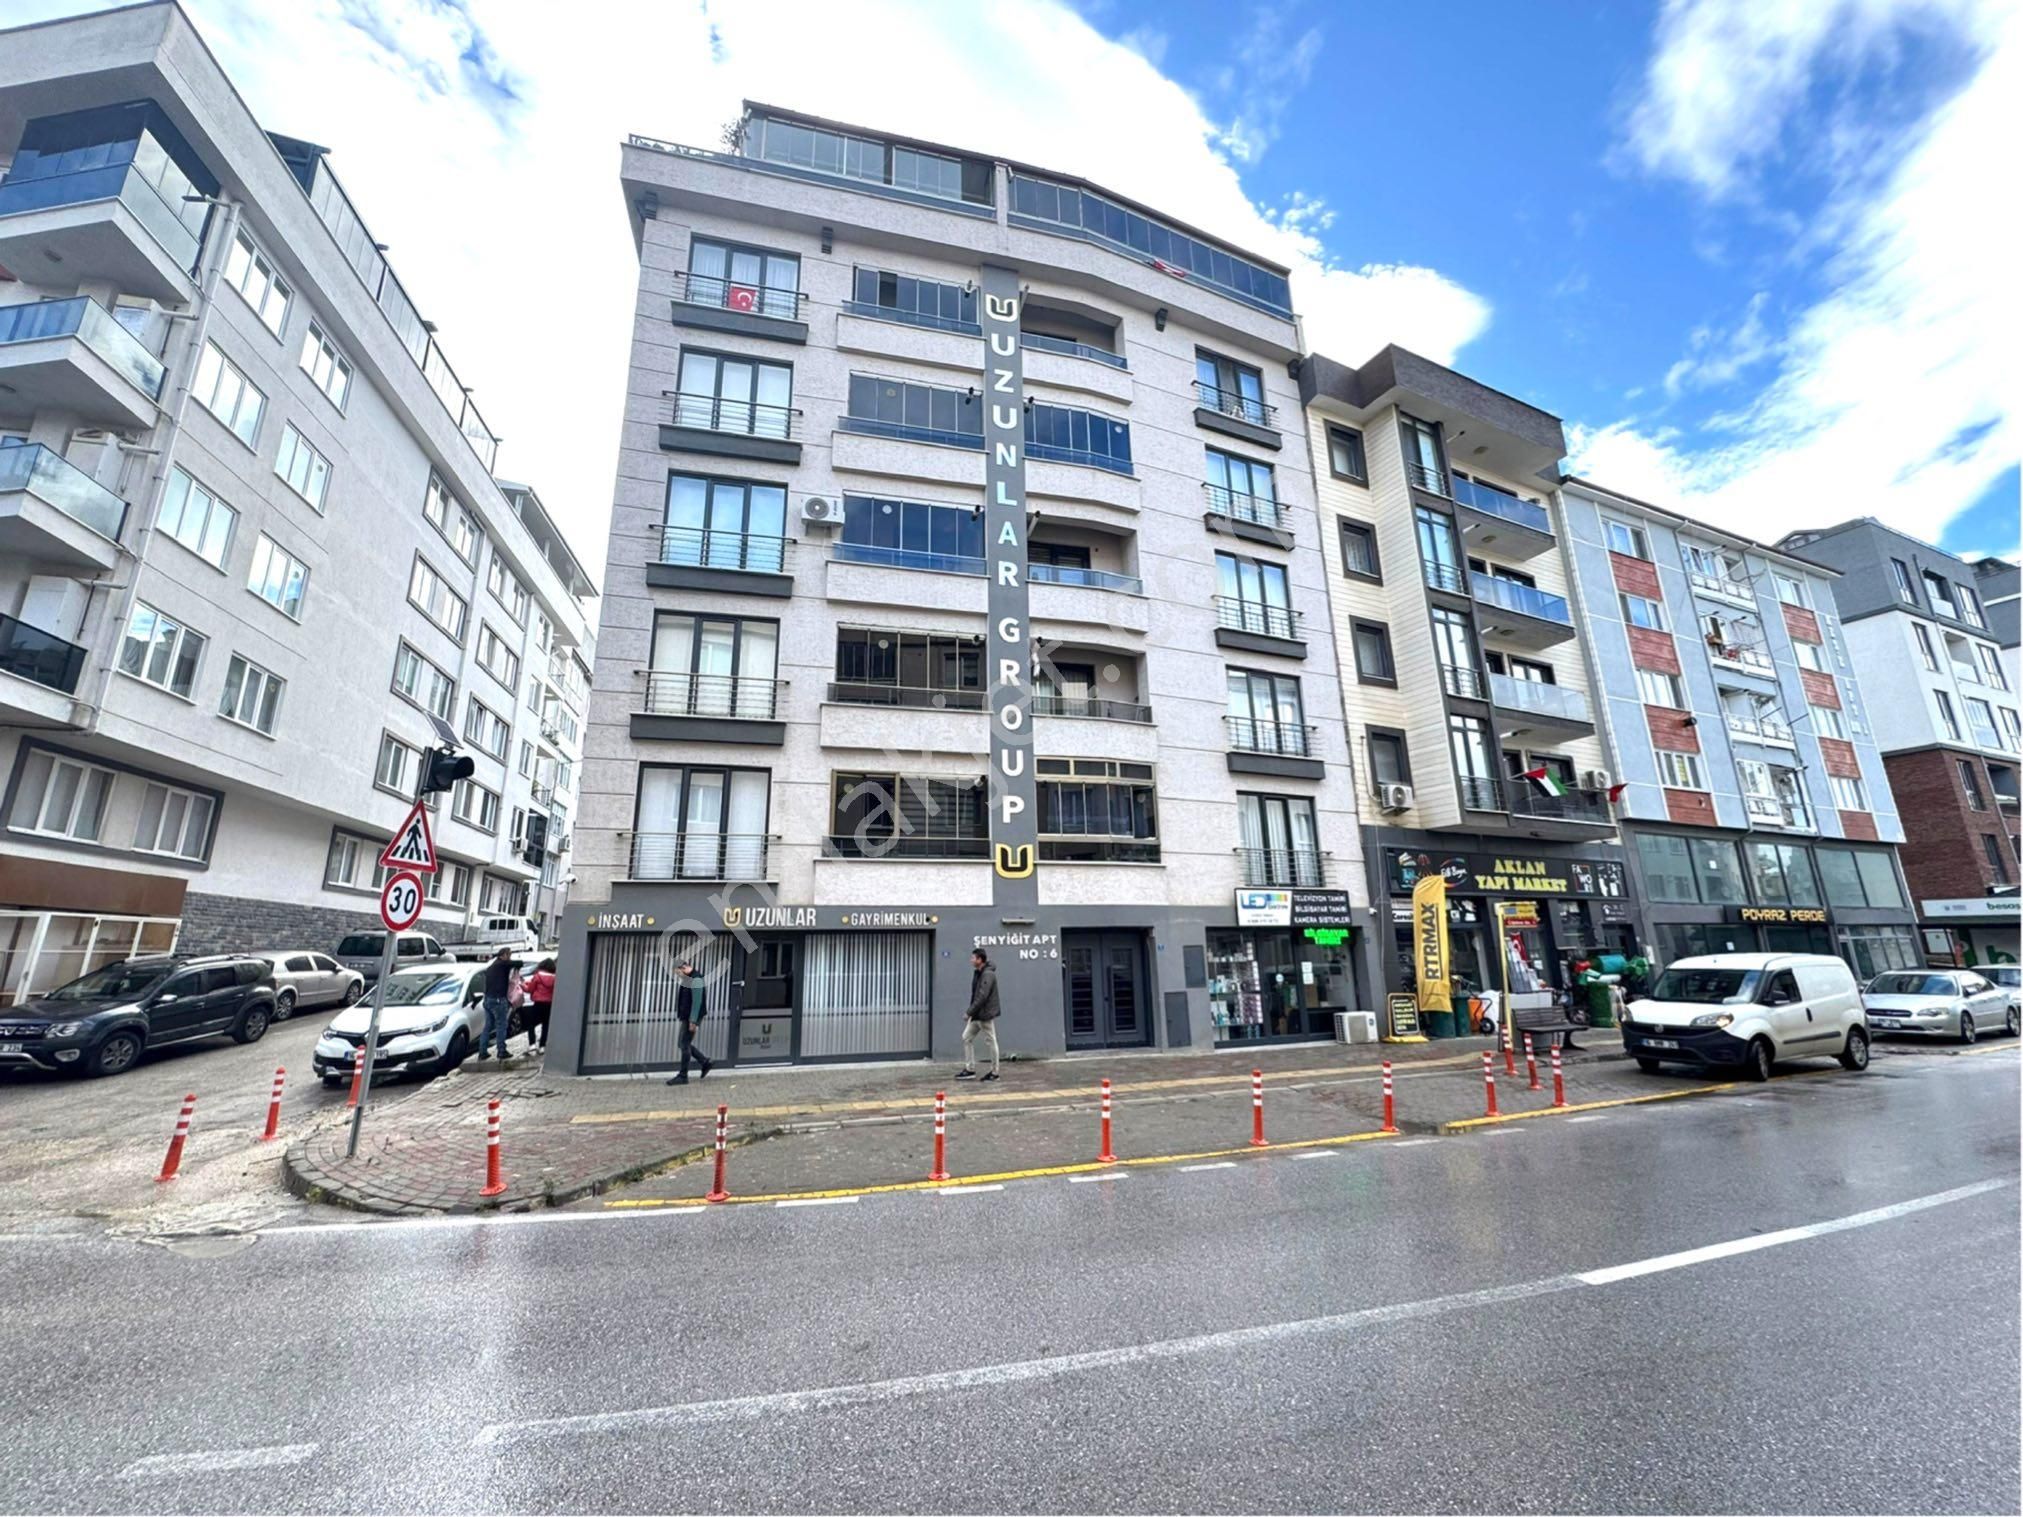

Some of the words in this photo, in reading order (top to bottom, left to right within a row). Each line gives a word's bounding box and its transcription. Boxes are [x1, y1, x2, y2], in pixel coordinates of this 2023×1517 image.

[990, 334, 1019, 587] UZUNLAR
[998, 617, 1025, 823] GROUP
[1494, 859, 1546, 875] AKLAN
[1474, 875, 1510, 890] YAPI
[1512, 877, 1567, 892] MARKET
[389, 886, 416, 914] 30
[598, 911, 644, 930] İNŞAAT
[745, 907, 816, 927] UZUNLAR
[851, 910, 929, 926] GAYRİMENKUL
[1742, 908, 1787, 921] POYRAZ
[1789, 910, 1826, 922] PERDE
[973, 932, 1030, 949] ŞENYİĞİT
[1032, 934, 1057, 945] APT
[1421, 903, 1440, 980] RTRMAX
[1019, 949, 1039, 959] NO
[1050, 948, 1058, 958] 6
